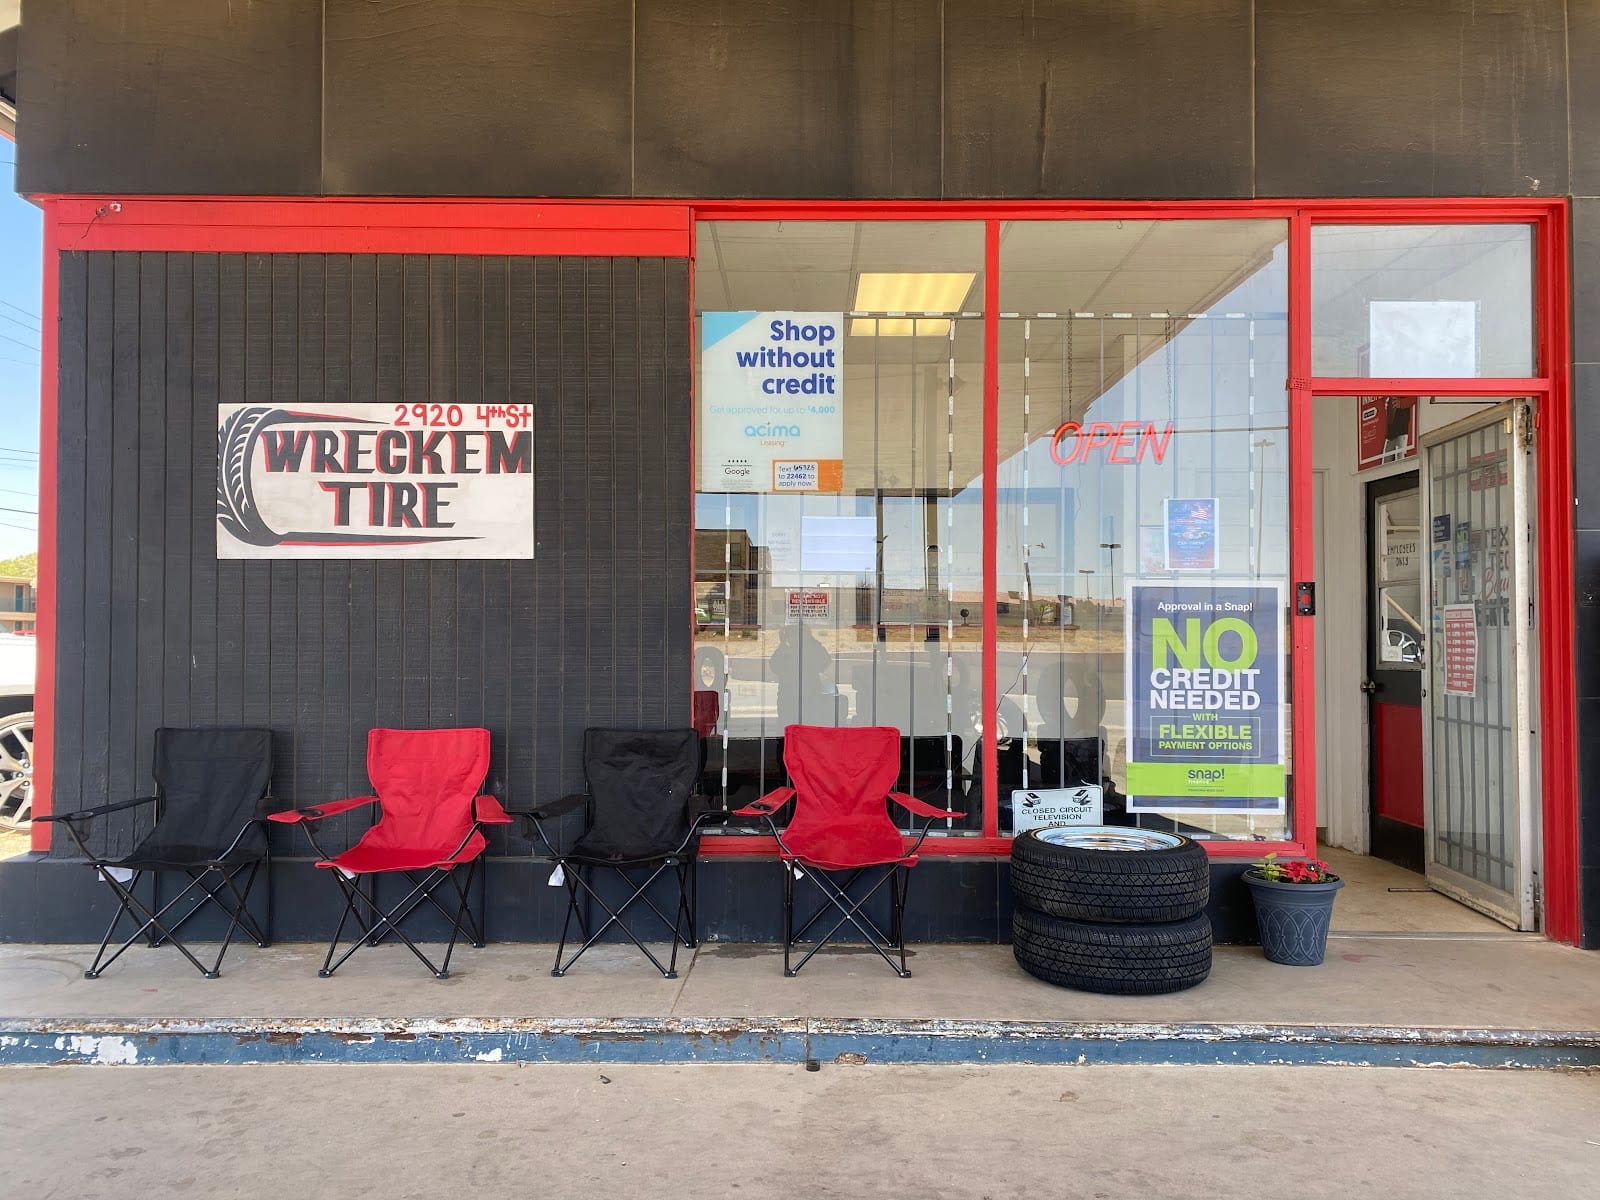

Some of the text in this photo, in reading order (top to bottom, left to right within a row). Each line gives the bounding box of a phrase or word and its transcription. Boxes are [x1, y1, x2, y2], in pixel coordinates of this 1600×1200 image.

[770, 320, 836, 346] Shop
[736, 346, 836, 368] without
[762, 373, 836, 394] credit
[394, 404, 463, 427] 2920
[709, 405, 725, 414] Get
[726, 405, 768, 417] approved
[769, 405, 782, 414] for
[783, 406, 795, 417] up
[807, 405, 836, 415] $4,000
[744, 422, 801, 437] acima
[1049, 420, 1174, 465] OPEN
[259, 430, 532, 474] WRECKEM
[724, 467, 751, 477] Google
[779, 465, 792, 473] Text
[778, 480, 797, 488] apply
[317, 481, 458, 528] TIRE
[1157, 602, 1253, 613] Approval in a Snap!
[1152, 617, 1258, 673] NO
[1150, 668, 1261, 690] CREDIT
[1150, 689, 1261, 710] NEEDED
[1192, 713, 1218, 721] WITH
[1159, 724, 1252, 740] FLEXIBLE
[1158, 741, 1252, 751] PAYMENT OPTIONS
[1188, 768, 1225, 782] snap!
[1021, 806, 1093, 815] CLOSED CIRCUIT
[1033, 813, 1082, 821] TELEVISION
